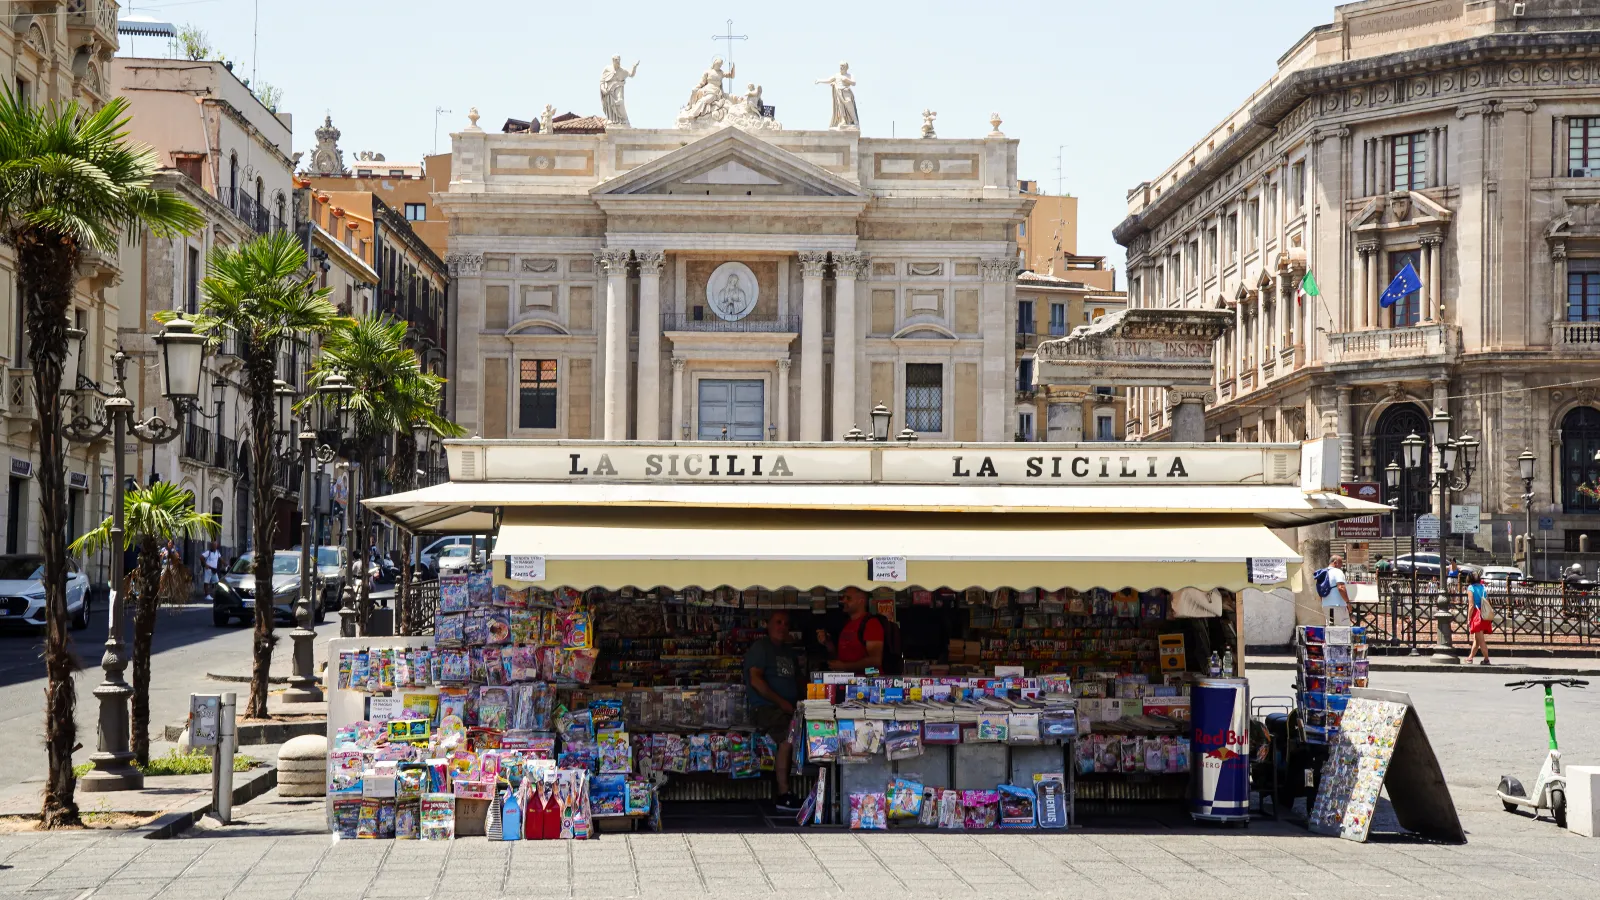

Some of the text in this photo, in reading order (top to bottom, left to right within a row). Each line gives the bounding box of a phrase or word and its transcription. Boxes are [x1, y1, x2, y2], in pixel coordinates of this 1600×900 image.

[1401, 4, 1453, 21] COMMERCIO
[1164, 342, 1212, 358] INSIGNE
[569, 453, 794, 477] LA SICILIA
[952, 456, 1189, 478] LA SICILIA
[1195, 728, 1249, 745] Red Bull
[1199, 761, 1226, 769] NERGY
[1045, 785, 1057, 822] JUVENTUS
